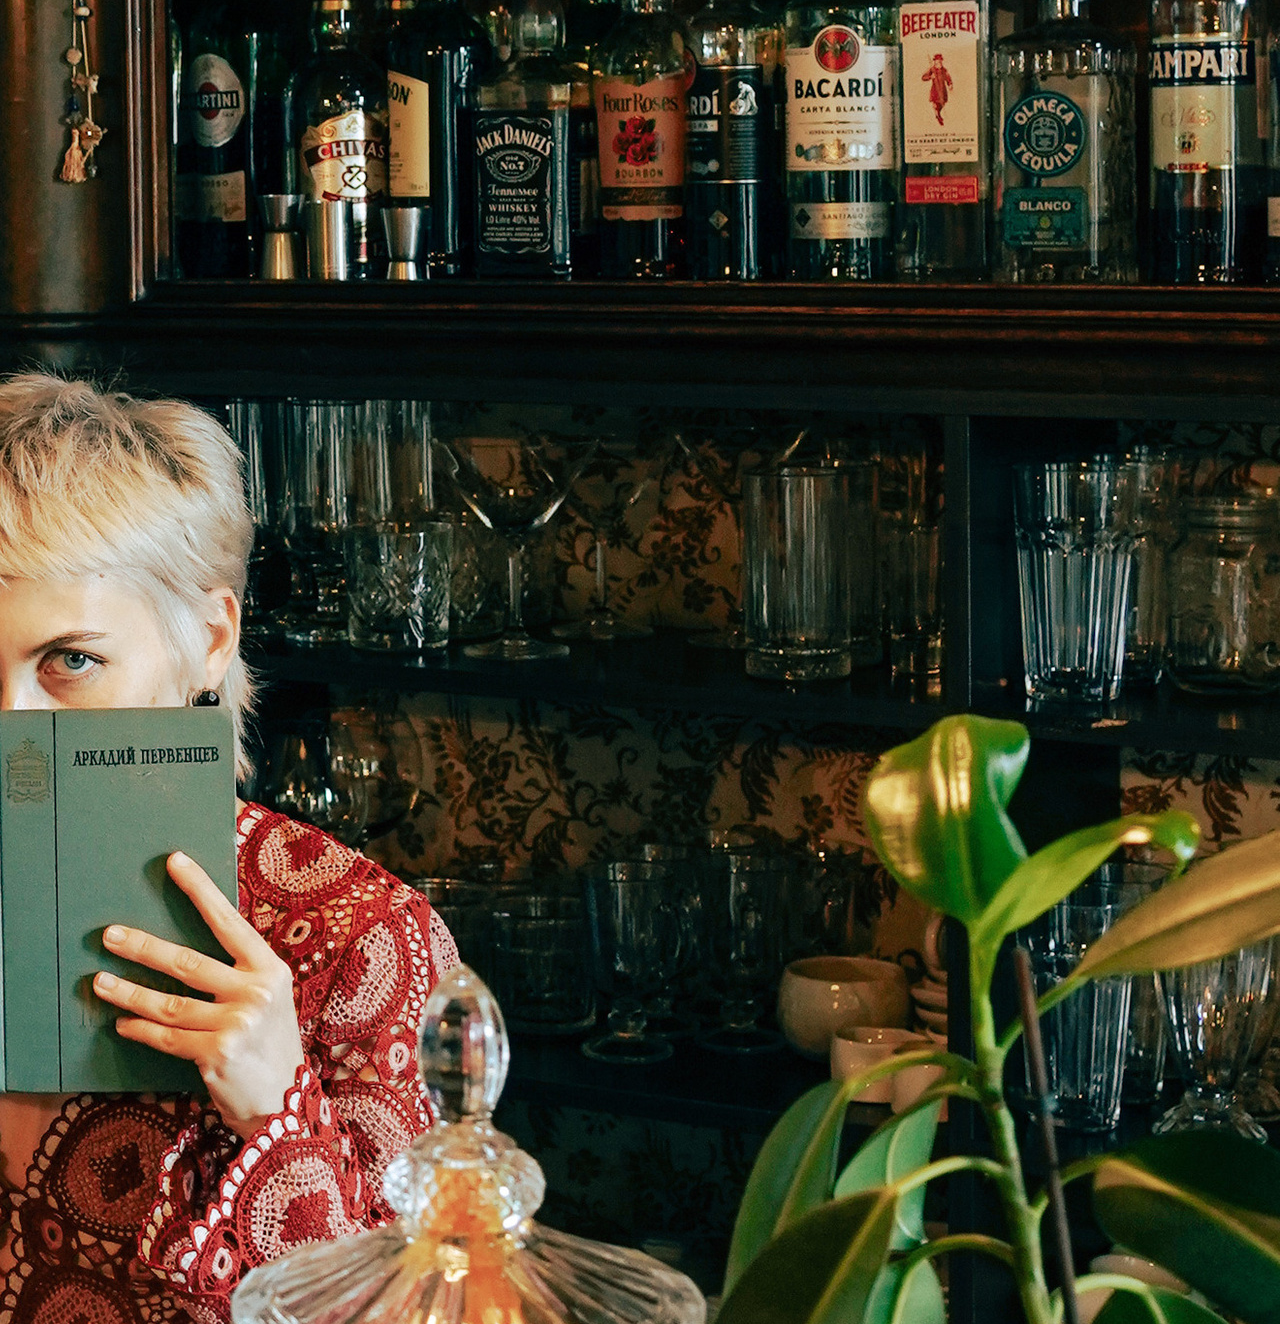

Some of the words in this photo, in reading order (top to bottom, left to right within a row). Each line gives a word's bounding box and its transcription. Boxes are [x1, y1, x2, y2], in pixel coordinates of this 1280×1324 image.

[901, 9, 977, 38] BEEFEATER
[919, 31, 957, 40] LONDON
[794, 71, 885, 99] BACARDÍ
[188, 90, 238, 109] ARTINI
[602, 93, 633, 113] Four
[633, 92, 680, 114] Roses
[800, 105, 831, 114] CARTA
[835, 104, 876, 113] BLANCA
[1013, 98, 1075, 126] OLMECA
[317, 140, 385, 161] CHIVAS
[476, 129, 503, 156] JACK
[504, 124, 555, 157] DANIEL'S
[1013, 142, 1079, 171] TEQUILA
[615, 167, 664, 179] BOURBON
[487, 183, 539, 197] Tennessee
[488, 203, 538, 213] WHISKEY
[1018, 201, 1072, 211] BLANCO
[72, 746, 136, 768] АРКАДИЙ
[140, 746, 220, 765] ПЕРВЕНЦЕВ
